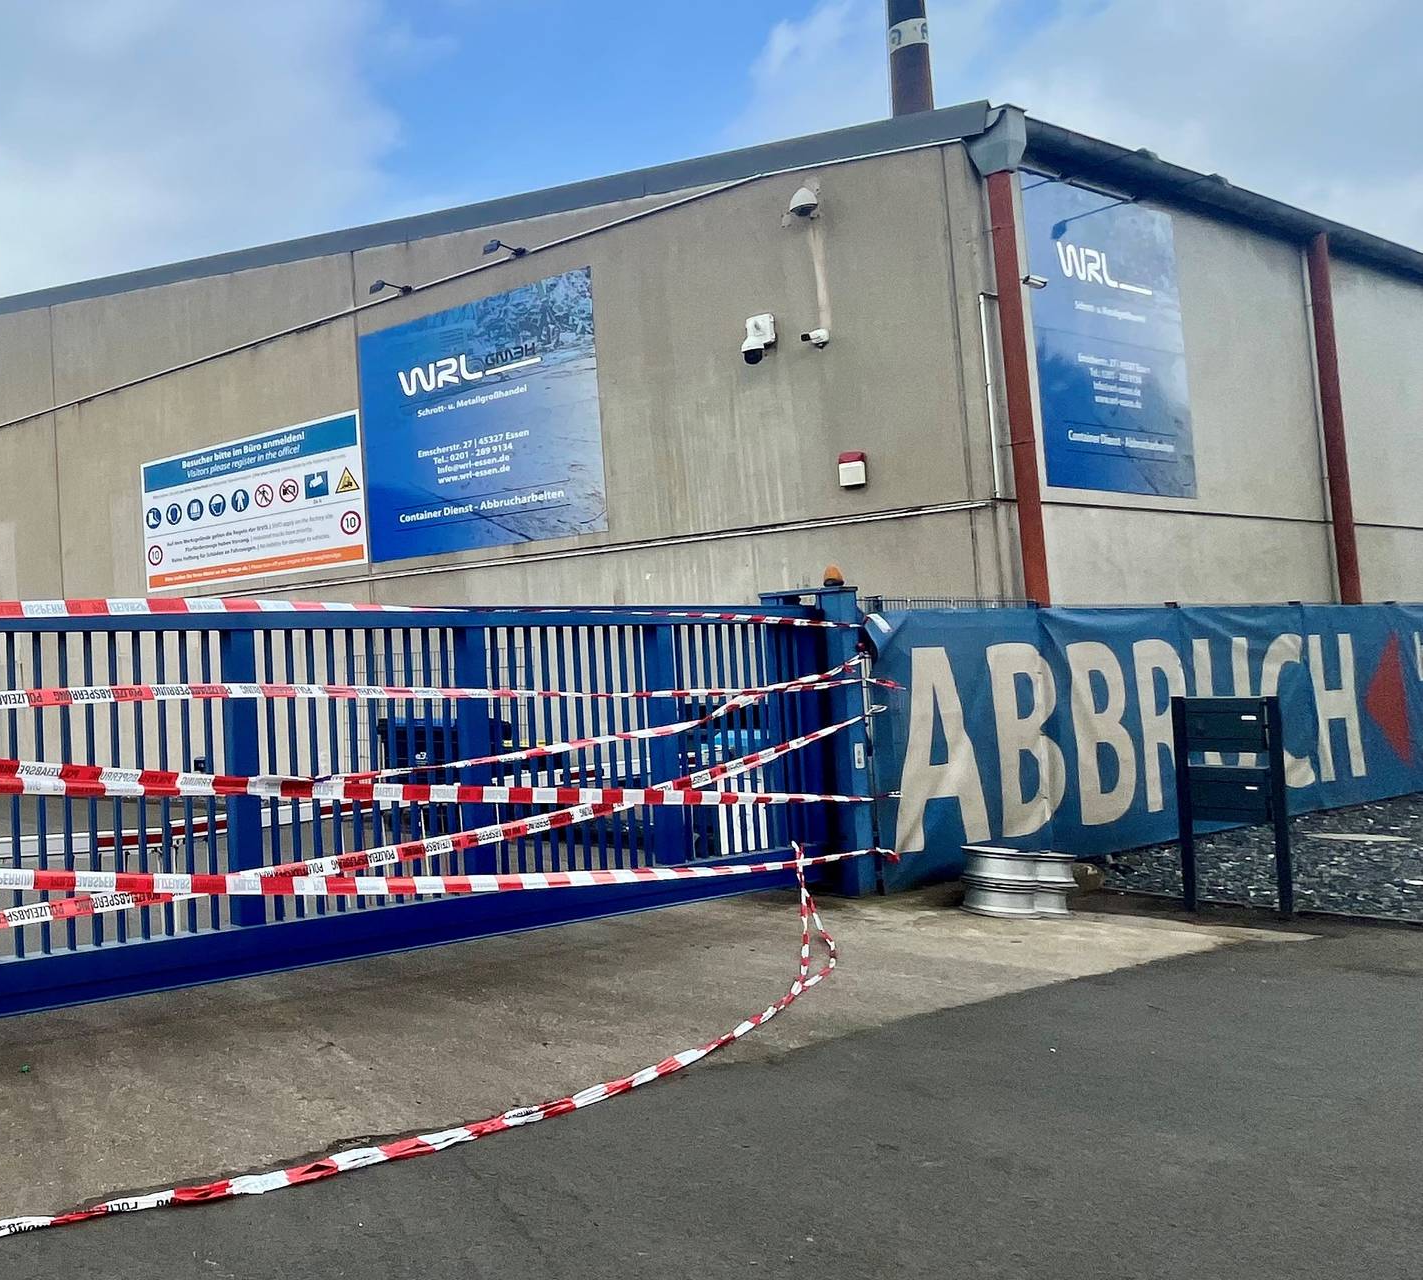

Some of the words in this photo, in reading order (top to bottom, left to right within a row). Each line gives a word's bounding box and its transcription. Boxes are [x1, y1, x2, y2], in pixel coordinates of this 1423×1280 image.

[1056, 241, 1119, 288] WRL
[397, 353, 483, 396] WRL
[181, 456, 214, 469] Besucher
[214, 452, 231, 461] bitte
[233, 448, 242, 456] im
[243, 444, 262, 454] Büro
[263, 431, 305, 449] anmelden!
[463, 440, 472, 449] 27
[478, 433, 503, 445] 45327
[505, 430, 530, 440] Essen
[450, 451, 469, 462] 0201
[492, 442, 513, 453] 9134
[187, 466, 209, 478] Visitors
[210, 461, 231, 475] please
[232, 455, 256, 469] register
[257, 453, 265, 462] in
[265, 451, 277, 460] the
[346, 517, 356, 529] 10
[399, 509, 443, 523] Container
[444, 504, 474, 516] Dienst
